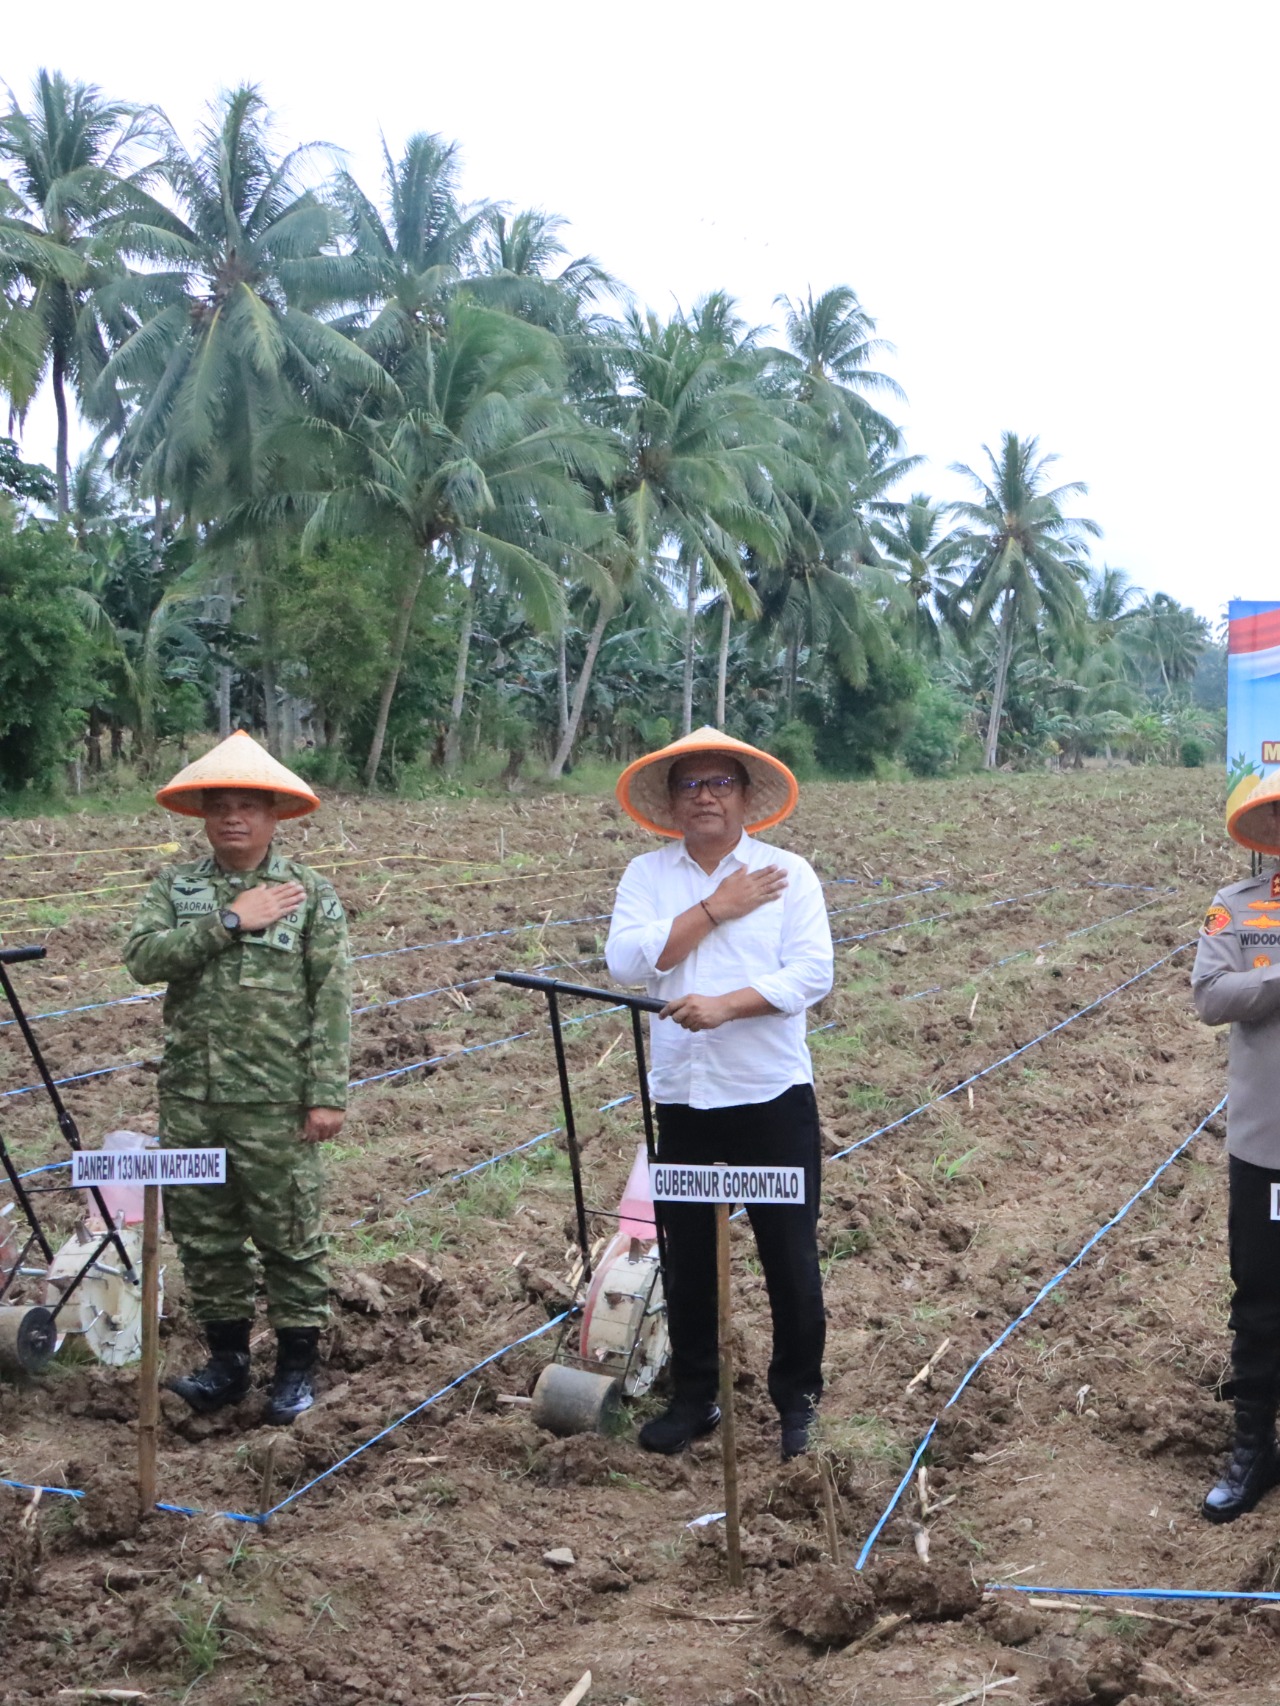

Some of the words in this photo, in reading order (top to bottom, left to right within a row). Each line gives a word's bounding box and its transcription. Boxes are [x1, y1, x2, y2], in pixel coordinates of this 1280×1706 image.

[78, 1155, 115, 1181] DANREM
[117, 1154, 158, 1180] 133/NANI
[160, 1153, 220, 1179] WARTABONE
[655, 1169, 720, 1197] GUBERNUR
[723, 1171, 799, 1199] GORONTALO
